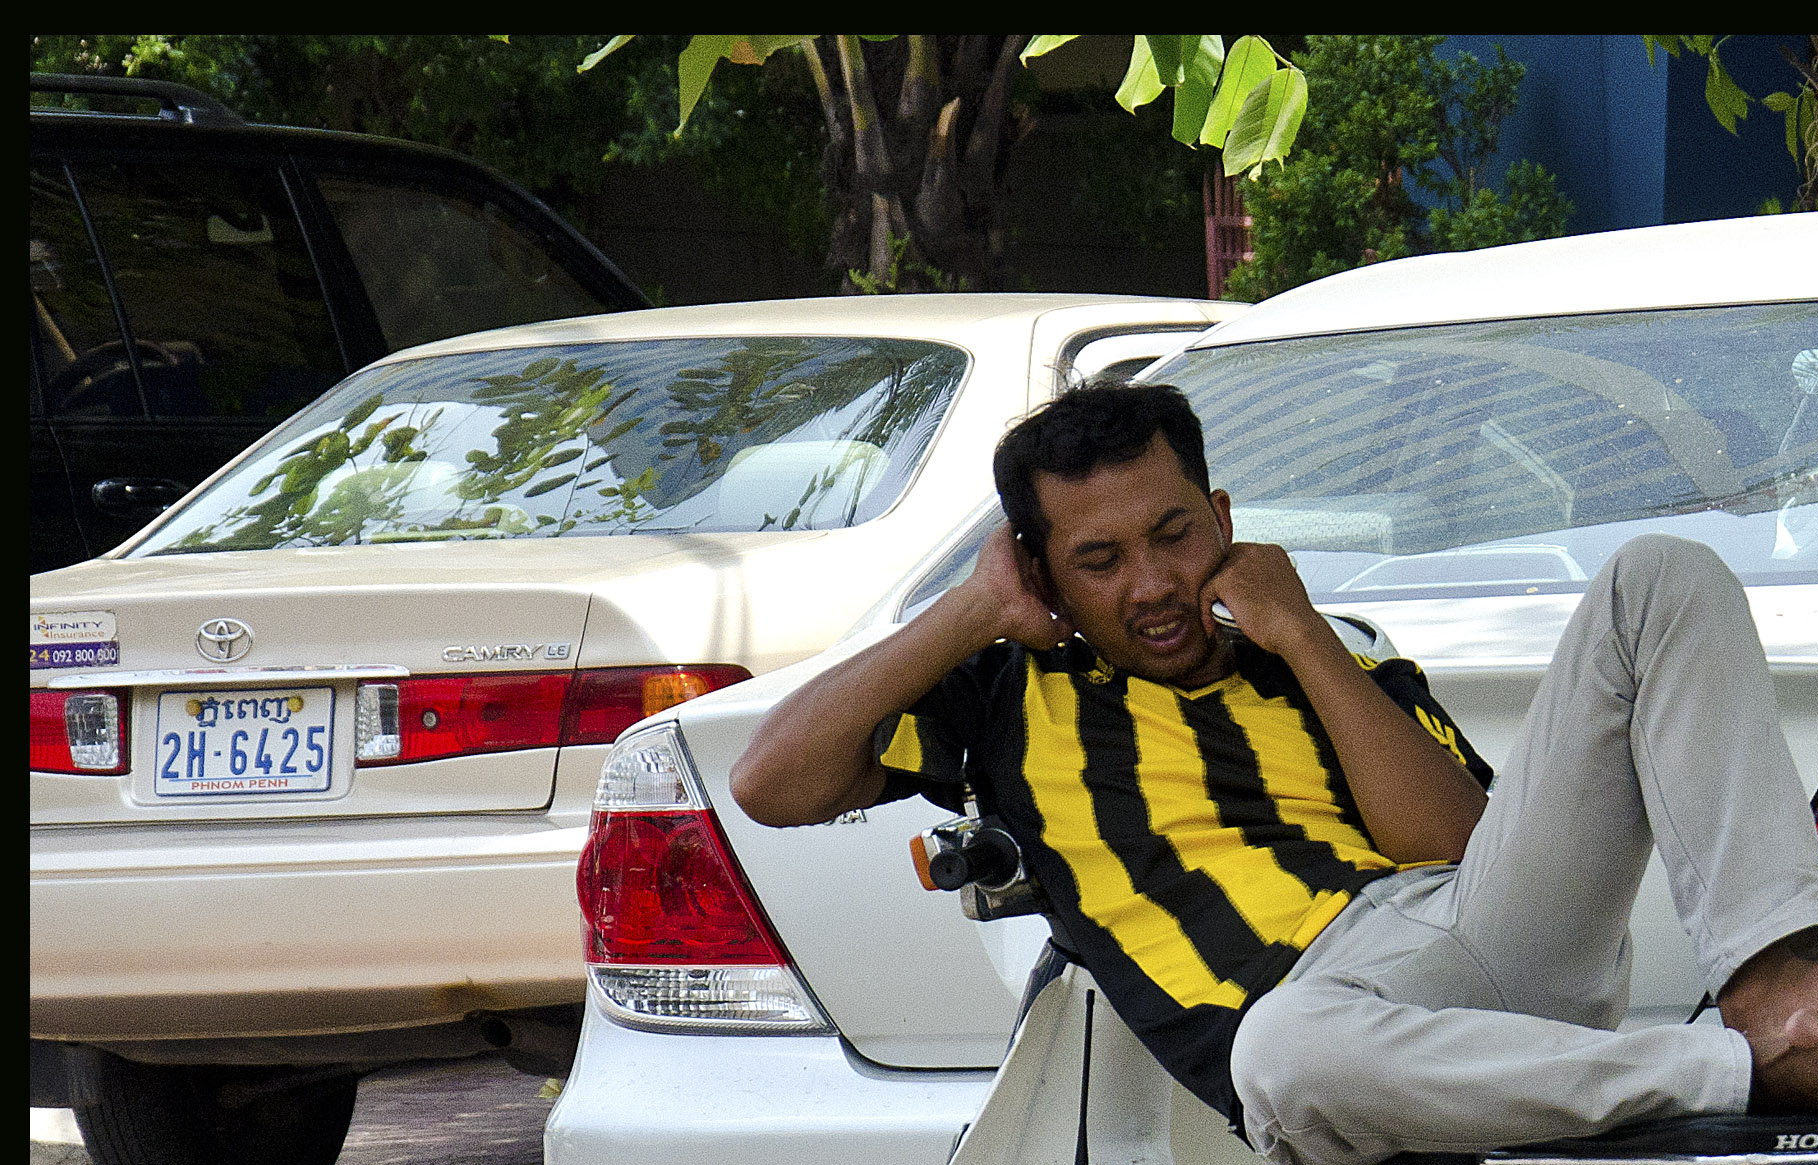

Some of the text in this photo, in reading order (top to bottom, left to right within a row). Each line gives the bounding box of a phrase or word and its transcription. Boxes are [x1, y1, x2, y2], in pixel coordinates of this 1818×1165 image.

[33, 621, 103, 631] INFINITY
[50, 630, 105, 639] Insurance
[52, 649, 73, 663] 092
[74, 648, 95, 663] 800
[442, 643, 567, 662] CAMRY LE
[160, 725, 326, 780] 2H-6425
[191, 778, 289, 791] PHNOM PENH
